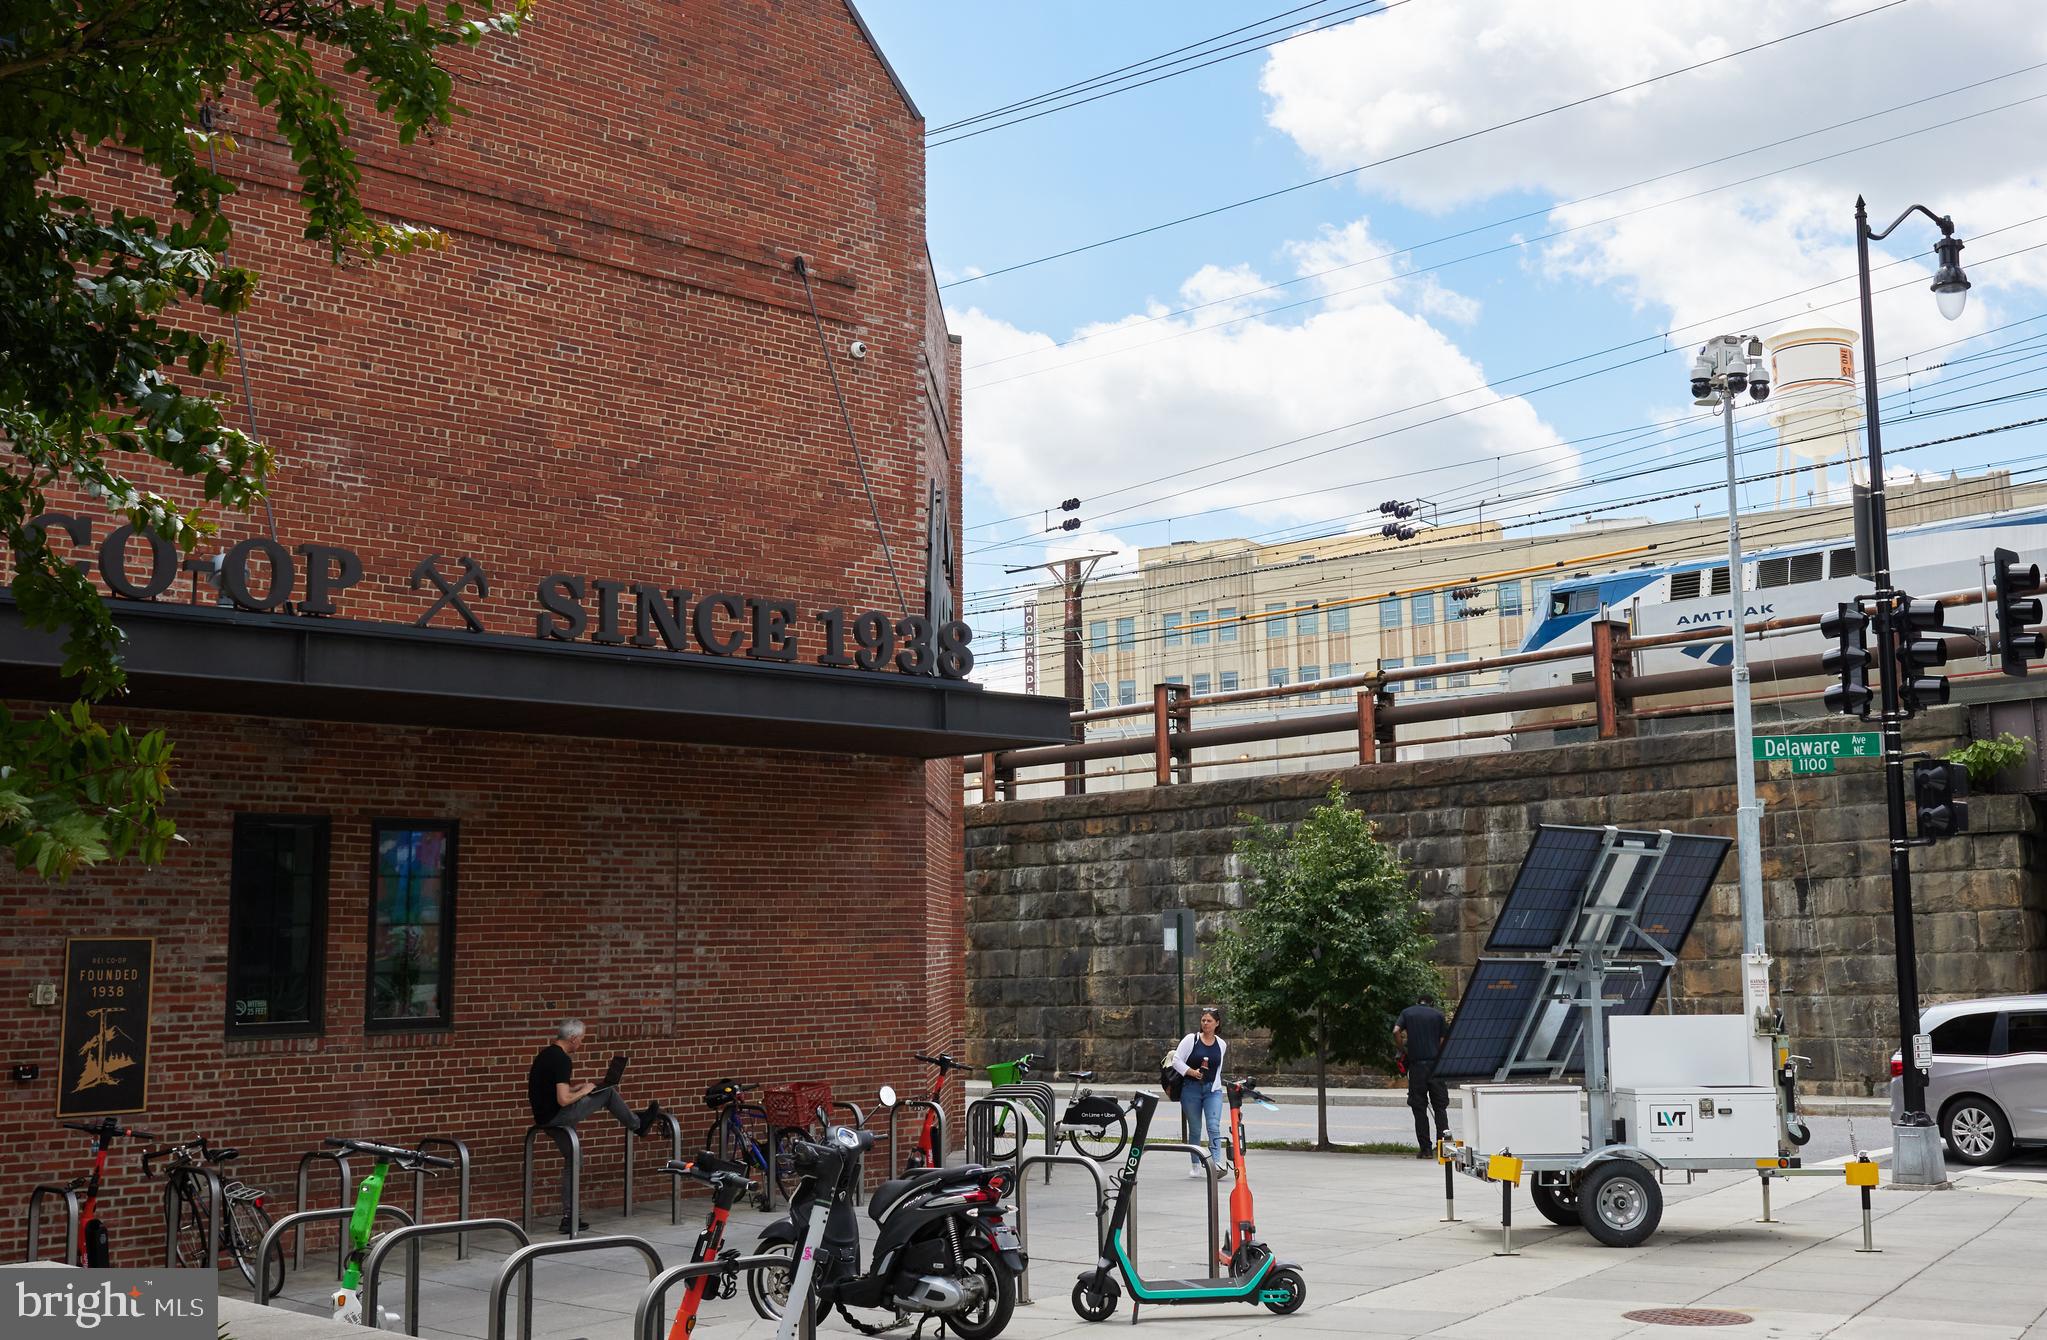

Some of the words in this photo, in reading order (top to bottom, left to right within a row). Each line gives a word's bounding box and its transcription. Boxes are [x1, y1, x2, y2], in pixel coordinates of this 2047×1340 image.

[536, 574, 798, 660] SINCE
[816, 607, 974, 678] 1938
[1025, 605, 1034, 684] WOODWARD
[1765, 739, 1840, 756] Delaware
[1851, 735, 1866, 744] Ave
[1853, 745, 1865, 755] NE
[1799, 758, 1827, 771] 1100
[80, 969, 138, 981] FOUNDED
[92, 986, 124, 998] 1938
[1657, 1111, 1687, 1126] LVT
[1125, 1147, 1140, 1175] veo
